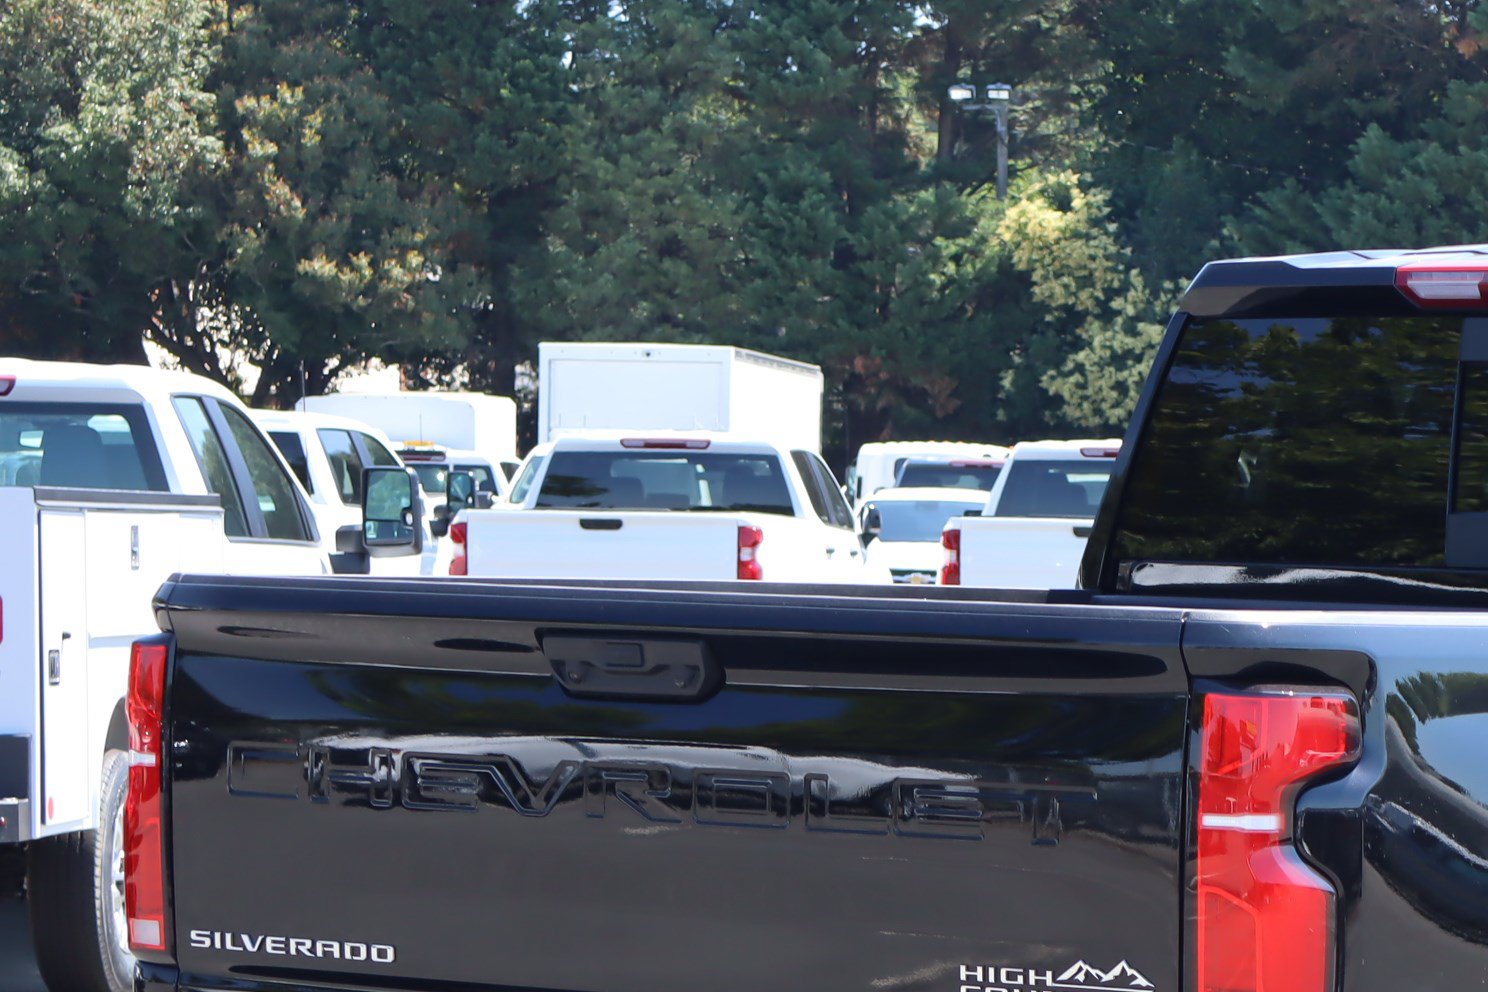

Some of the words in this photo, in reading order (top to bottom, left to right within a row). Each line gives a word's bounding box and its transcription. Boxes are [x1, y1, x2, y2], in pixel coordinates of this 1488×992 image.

[226, 739, 1098, 846] CHEVROLET
[190, 929, 396, 963] SILVERADO
[959, 964, 1053, 987] HIGH
